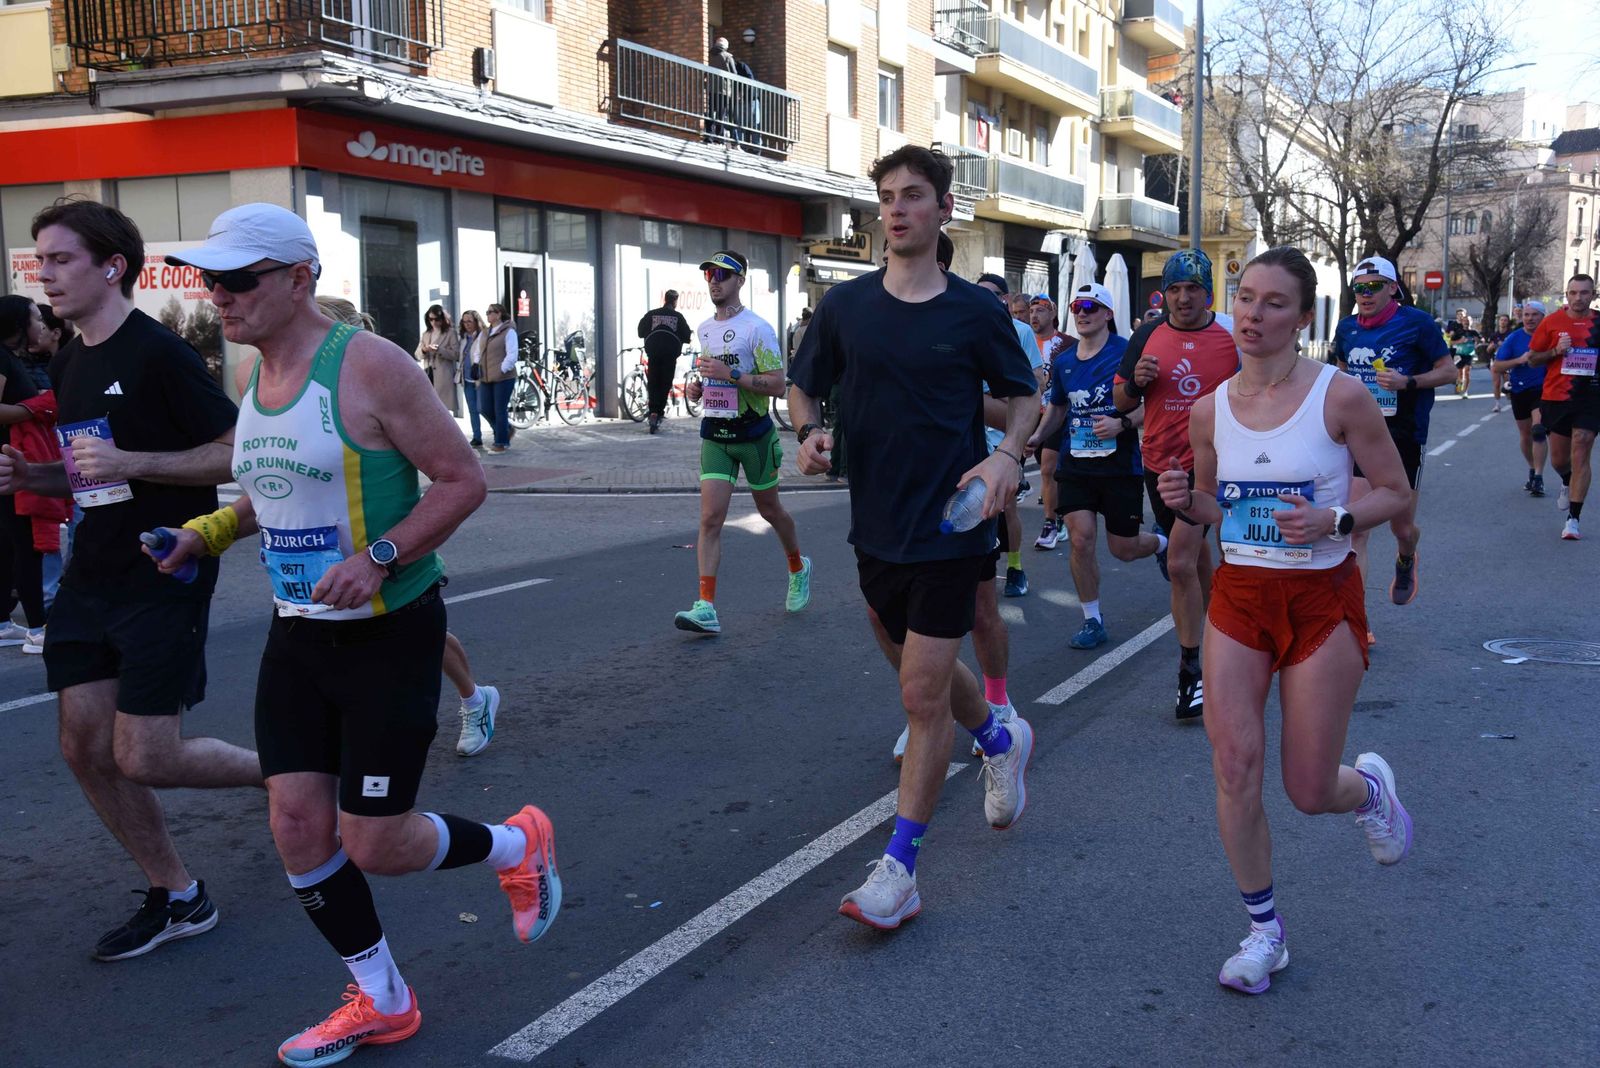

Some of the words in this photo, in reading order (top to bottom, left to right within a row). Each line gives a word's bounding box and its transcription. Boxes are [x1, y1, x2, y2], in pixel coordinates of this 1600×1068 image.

[388, 142, 485, 176] mapfre
[138, 266, 158, 289] DE
[161, 265, 208, 289] COCH
[319, 396, 332, 434] 2XU
[705, 398, 729, 409] PEDRO
[242, 437, 298, 453] ROYTON
[256, 457, 334, 483] RUNNERS
[1247, 487, 1301, 498] ZURICH
[273, 533, 325, 549] ZURICH
[314, 1029, 376, 1059] BROOKS
